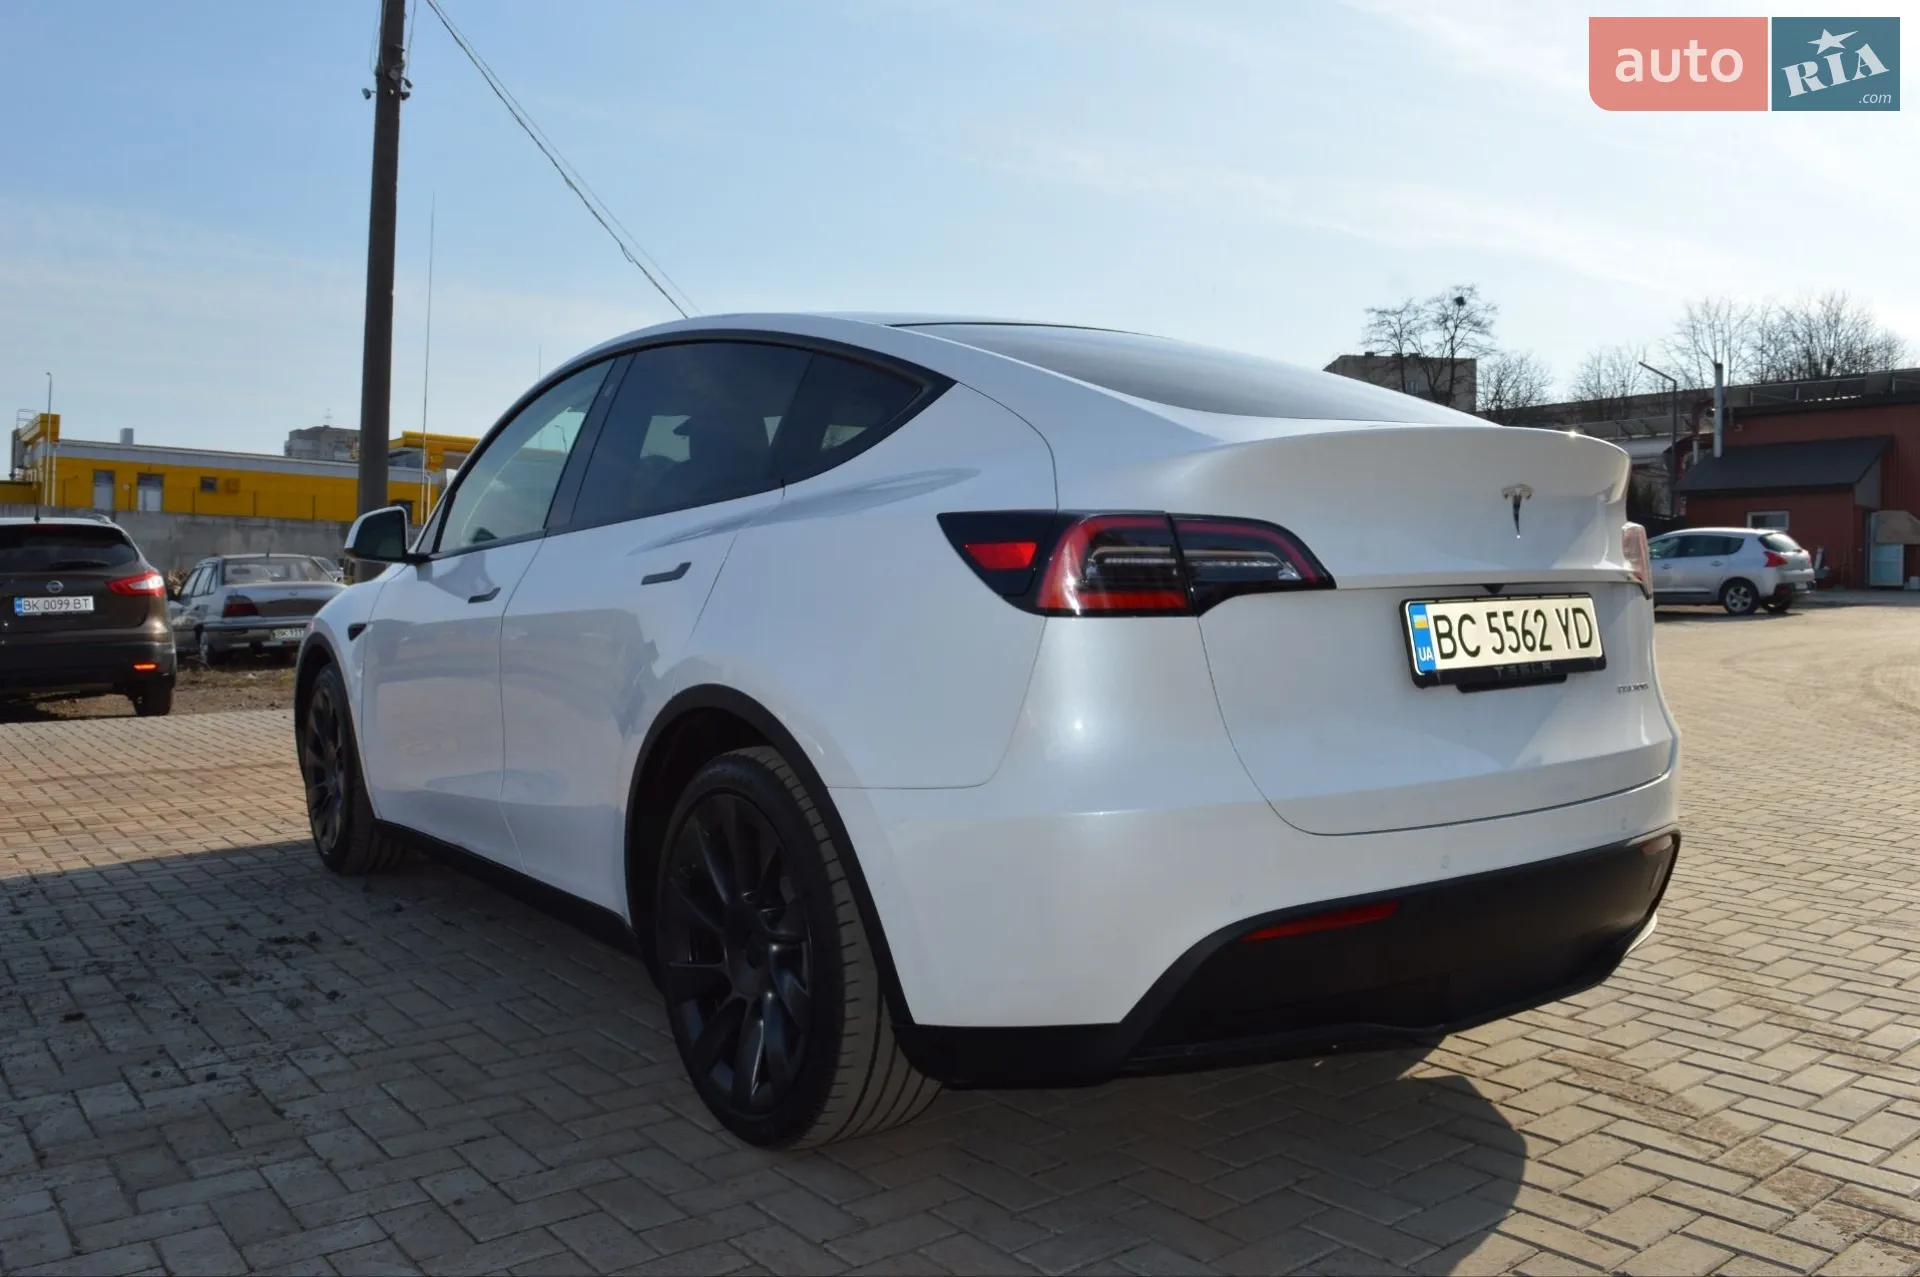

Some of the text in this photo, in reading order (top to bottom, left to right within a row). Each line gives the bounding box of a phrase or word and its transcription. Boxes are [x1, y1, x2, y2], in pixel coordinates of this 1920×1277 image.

[23, 598, 90, 612] BK 0099 BT
[1433, 607, 1593, 661] BC 5562 YD
[1418, 646, 1435, 662] UA
